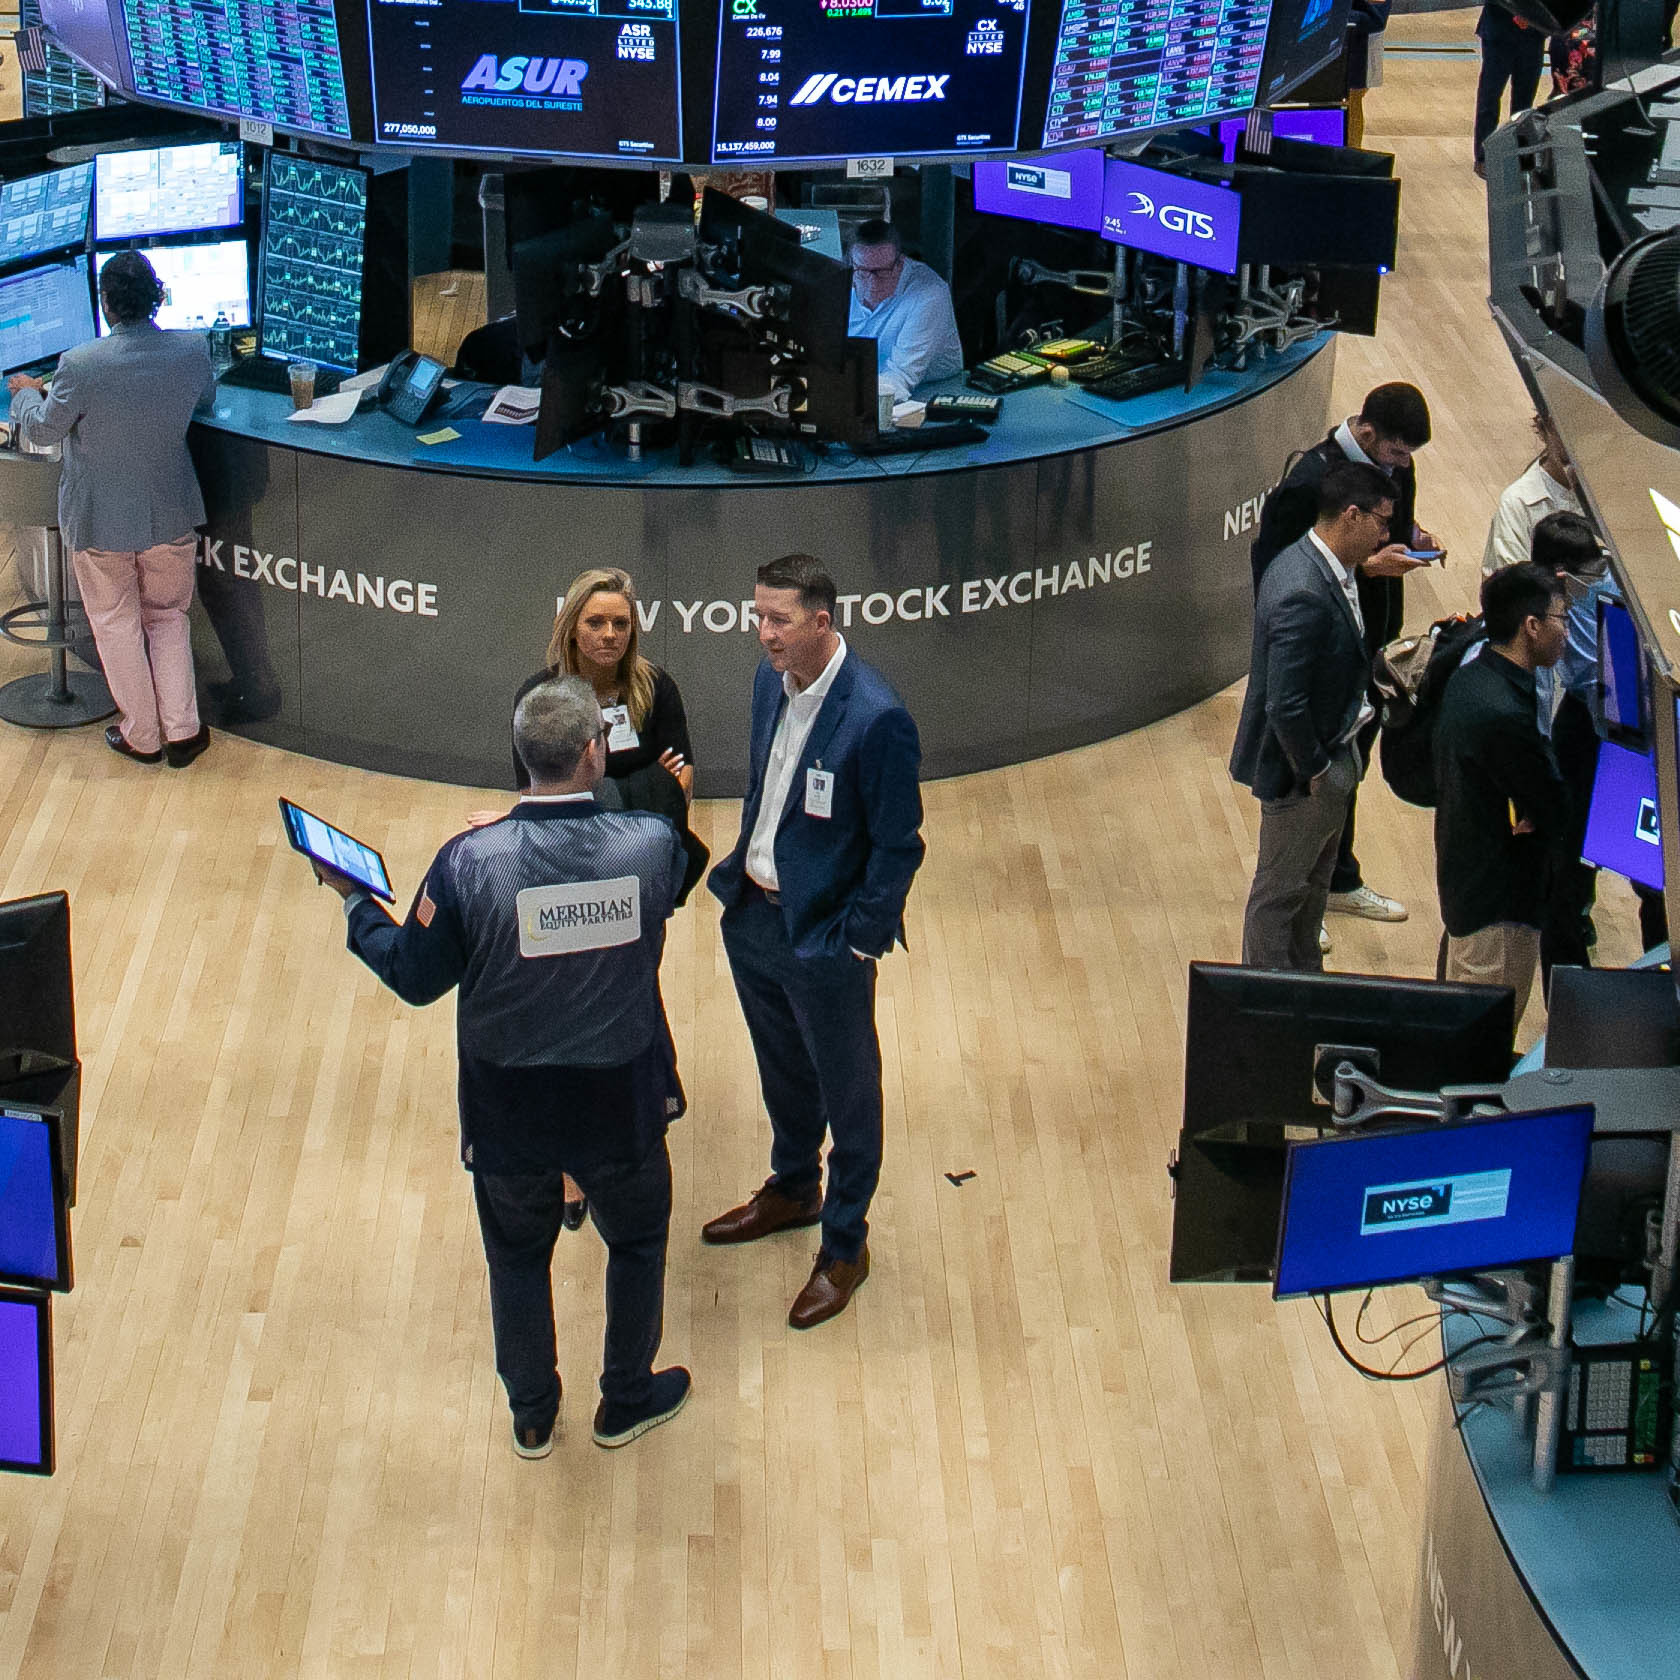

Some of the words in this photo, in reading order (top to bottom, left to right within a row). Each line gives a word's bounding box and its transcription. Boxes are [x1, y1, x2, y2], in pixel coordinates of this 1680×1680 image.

[621, 24, 650, 36] ASR
[977, 20, 997, 31] CX
[746, 26, 782, 38] 226,676
[969, 33, 1004, 41] LISTED
[618, 38, 654, 46] LISTED
[617, 47, 655, 60] NYSE
[967, 43, 1003, 54] NYSE
[761, 50, 781, 60] 7.99
[462, 54, 588, 94] ASUR
[759, 73, 779, 83] 8.04
[832, 75, 950, 102] CEMEX
[462, 96, 524, 108] AEROPUERTOS
[526, 99, 543, 109] DEL
[544, 100, 582, 111] SURESTE
[759, 95, 778, 105] 7.94
[244, 121, 266, 136] 1012
[757, 118, 776, 128] 8.00
[384, 123, 436, 136] 277,050,000
[856, 160, 885, 171] 1632
[1159, 205, 1214, 239] GTS
[232, 546, 439, 618] EXCHANGE
[673, 600, 759, 632] YOR
[839, 584, 951, 627] TOCK
[961, 541, 1153, 614] EXCHANGE
[540, 897, 632, 921] MERIDIAN
[540, 918, 578, 930] EQUITY
[582, 911, 633, 925] PARTNERS
